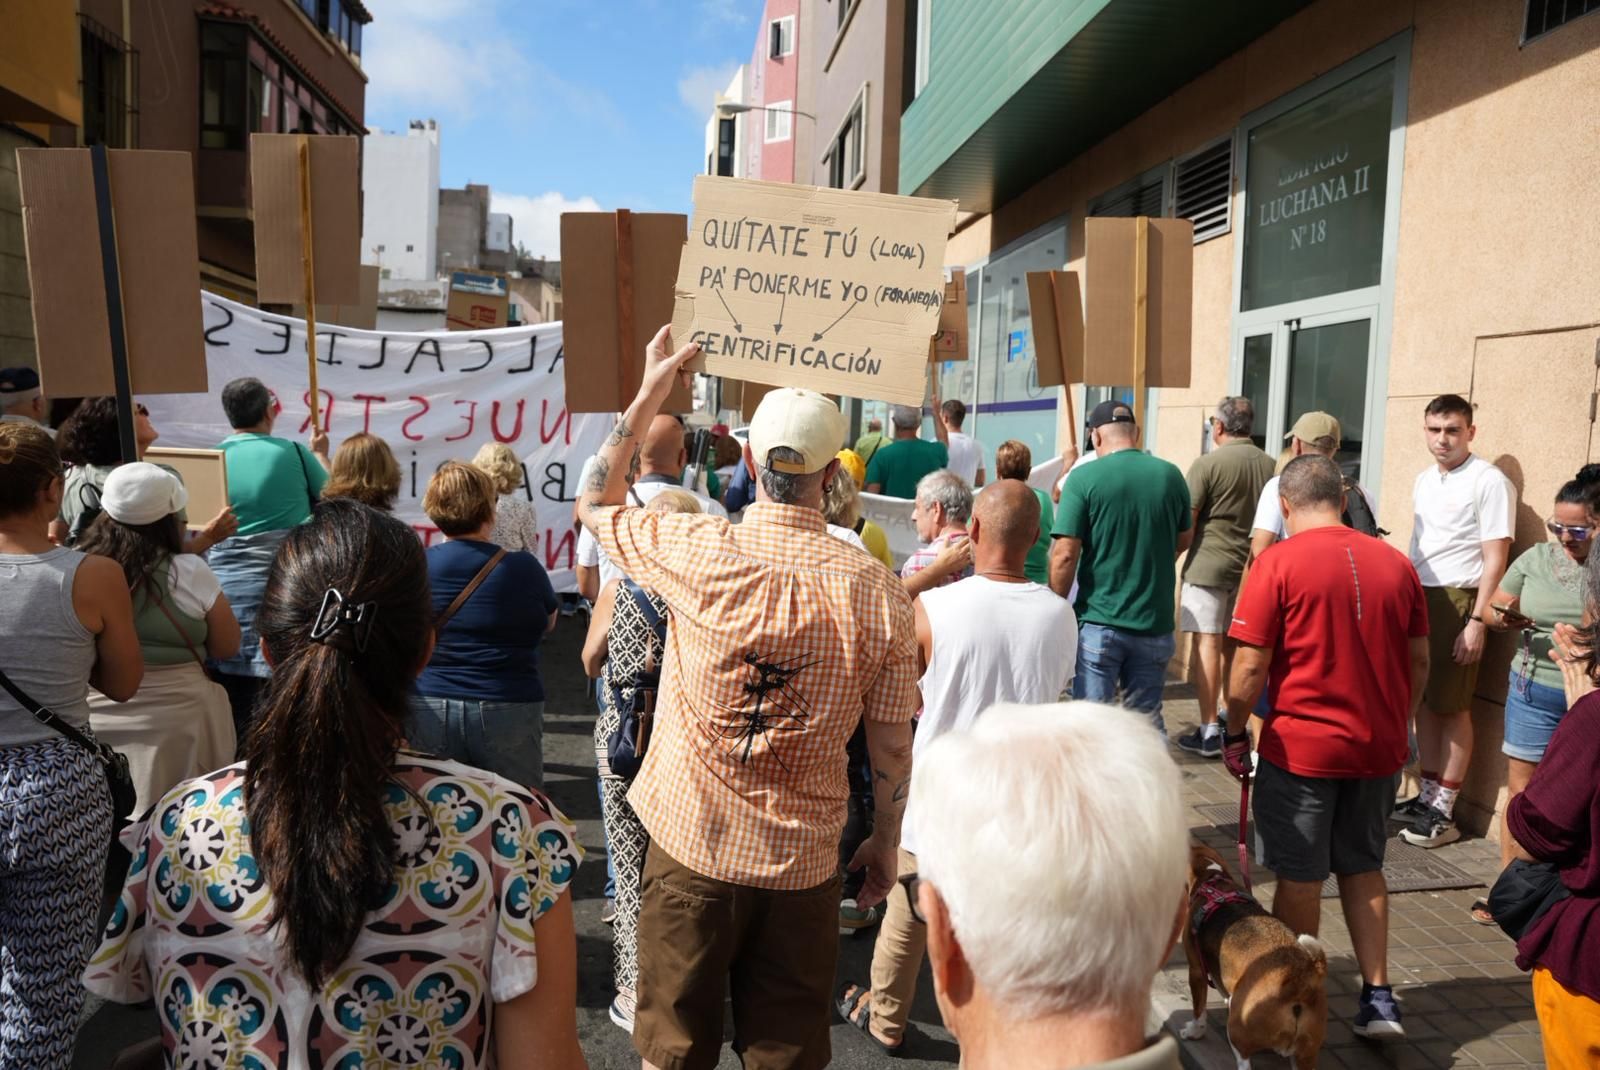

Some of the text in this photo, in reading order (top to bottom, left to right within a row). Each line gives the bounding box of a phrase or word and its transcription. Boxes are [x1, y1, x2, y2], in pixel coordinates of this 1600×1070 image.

[1259, 165, 1371, 227] LUCHANA II
[703, 216, 925, 270] QUÍTATE TÚ (LOCAL)
[732, 267, 832, 300] PONERME
[840, 280, 869, 303] YO
